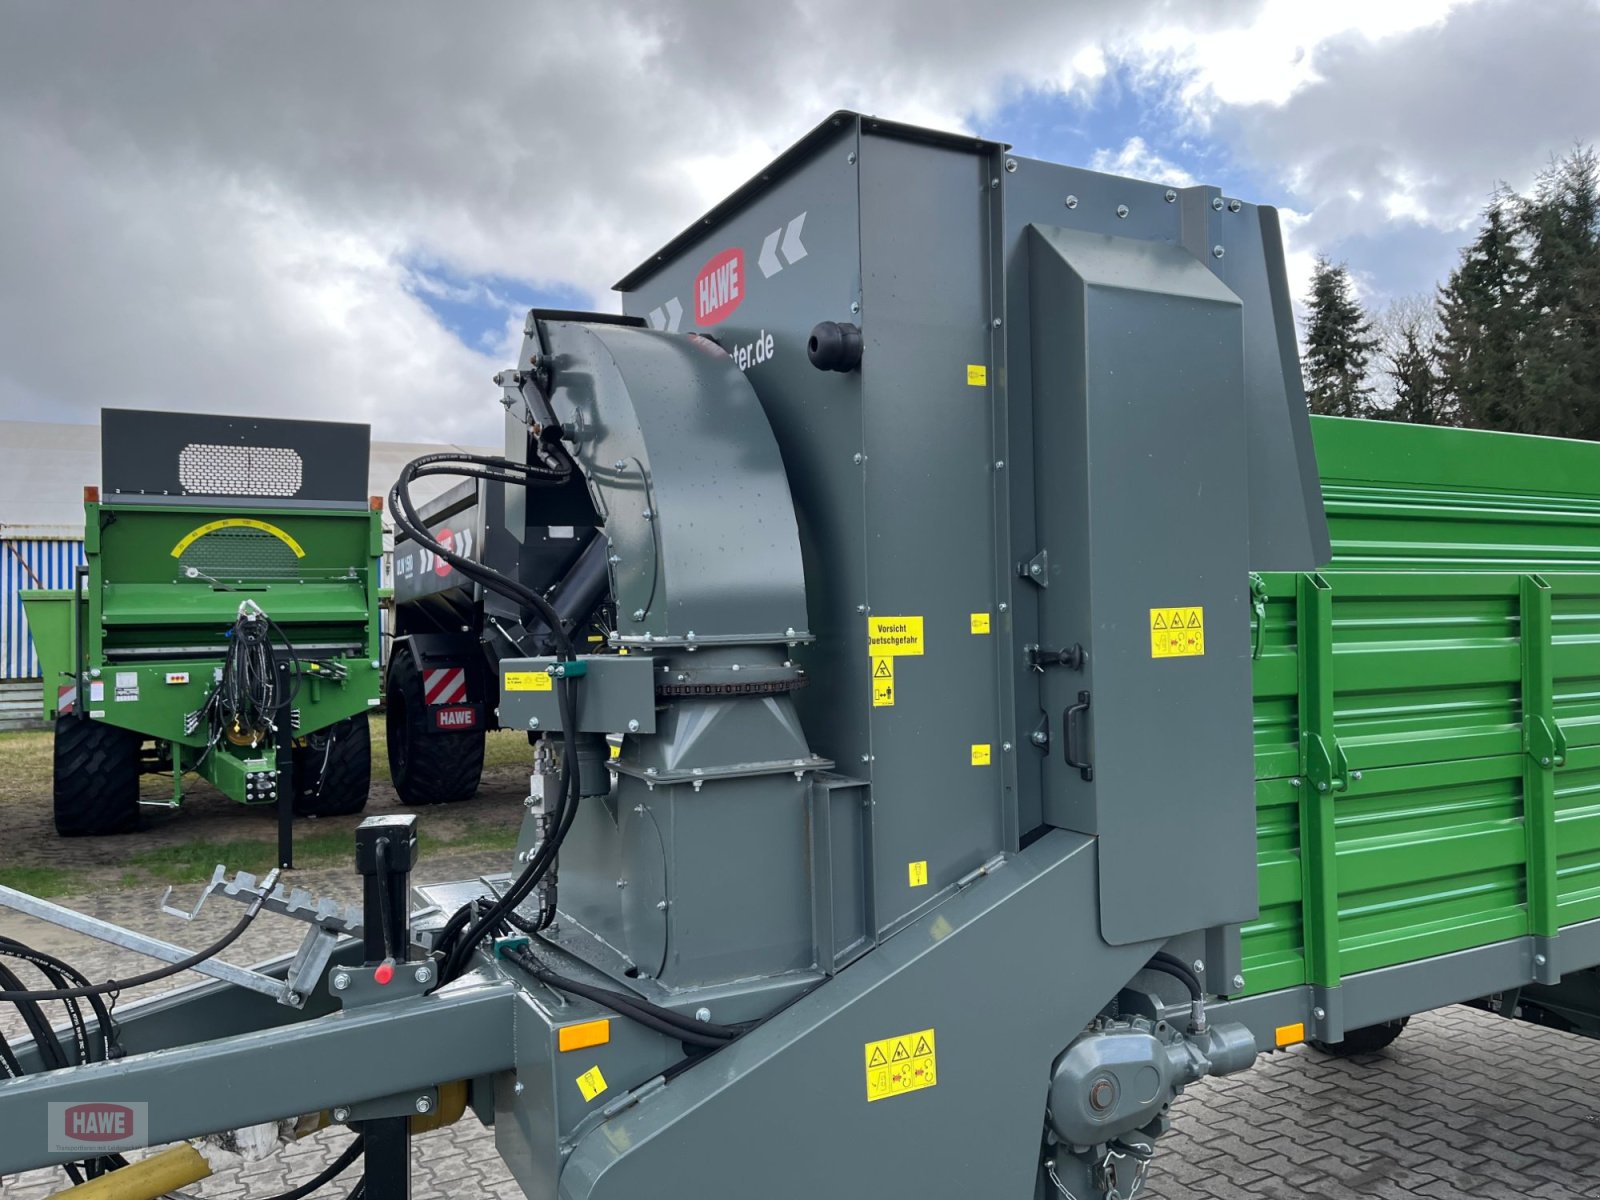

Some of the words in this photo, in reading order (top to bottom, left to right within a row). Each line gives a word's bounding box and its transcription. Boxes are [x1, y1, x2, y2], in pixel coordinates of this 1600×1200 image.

[700, 257, 738, 317] HAWE
[877, 624, 907, 633] Vorsicht
[440, 711, 472, 725] HAWE
